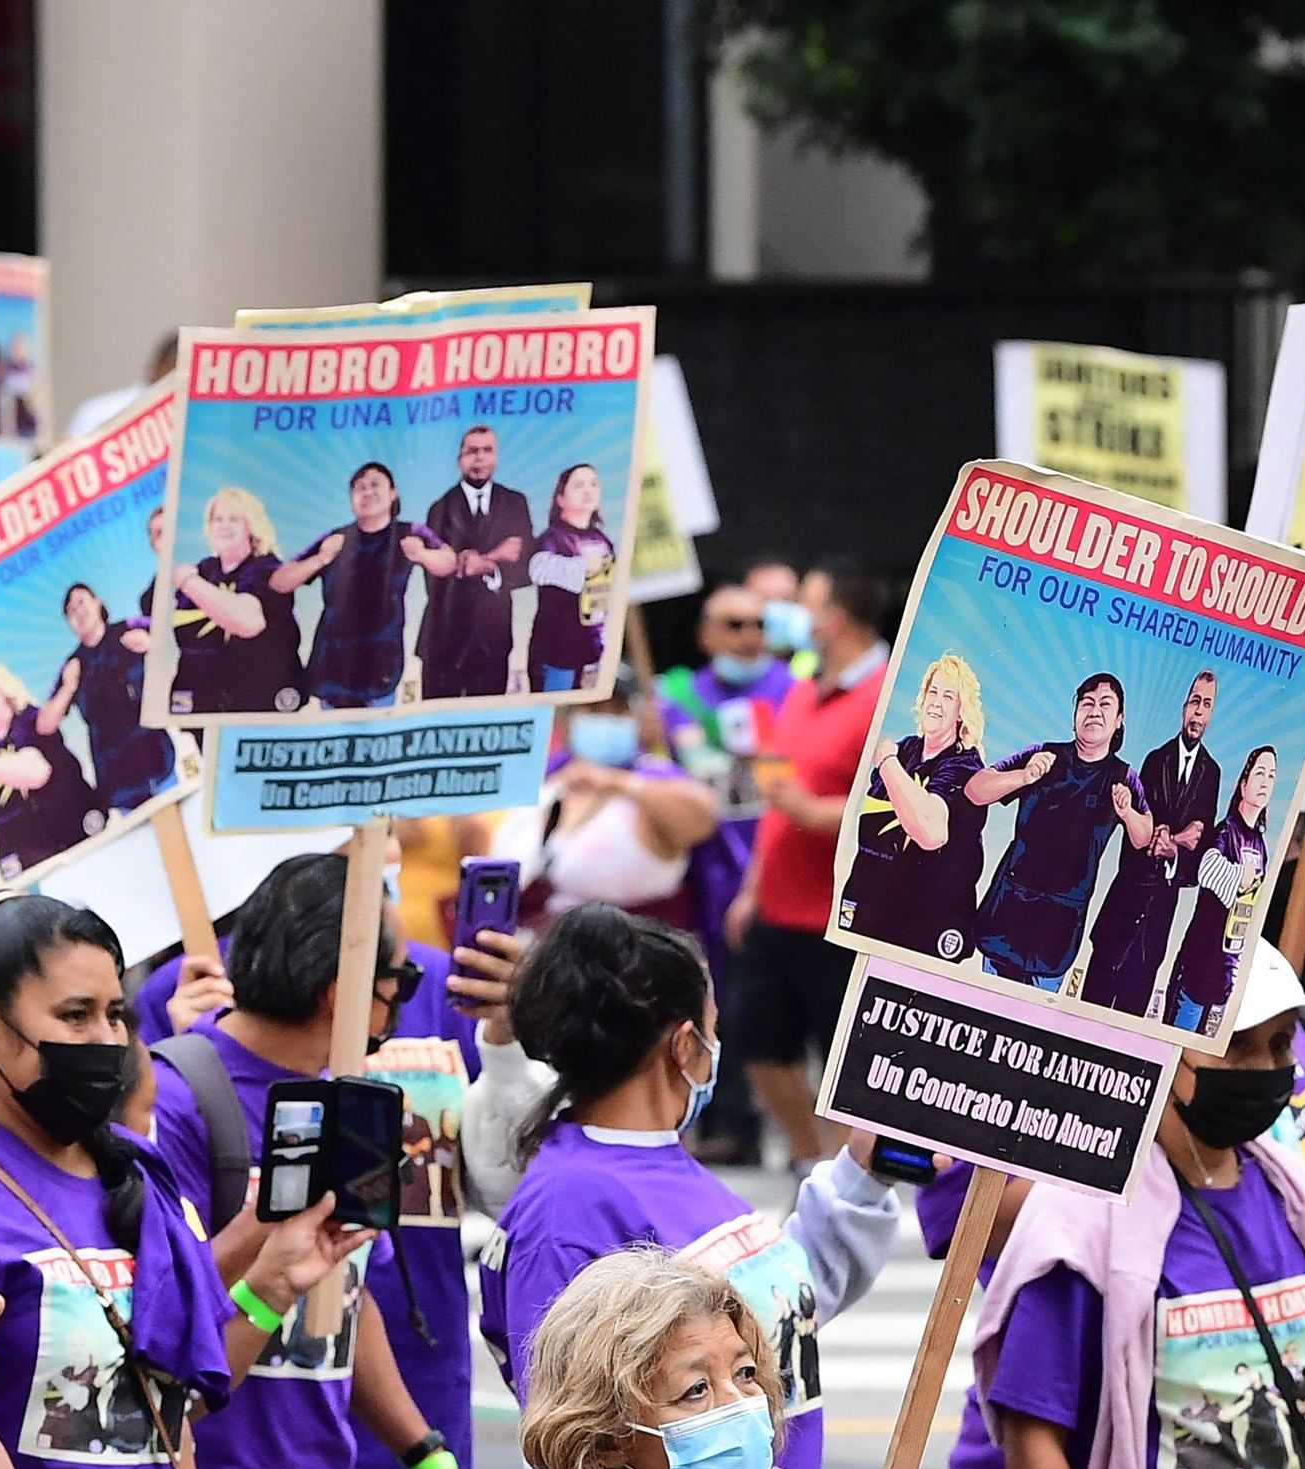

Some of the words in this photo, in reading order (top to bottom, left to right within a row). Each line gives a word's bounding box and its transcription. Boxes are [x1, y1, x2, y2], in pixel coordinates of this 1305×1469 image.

[196, 345, 401, 396] HOMBRO
[411, 344, 435, 390] A
[444, 329, 636, 382] HOMBRO
[254, 403, 315, 431] POR
[331, 400, 392, 428] UNA
[406, 396, 461, 425] VIDA
[474, 388, 575, 419] MEJOR
[55, 453, 101, 507] TO
[956, 475, 1162, 588] SHOULDER
[1164, 538, 1209, 602] TO
[978, 554, 1033, 597] FOR
[1039, 573, 1097, 618] OUR
[1107, 595, 1200, 648] SHARED
[1201, 627, 1303, 681] HUMANITY
[235, 737, 348, 769] JUSTICE
[352, 735, 404, 764] FOR
[862, 996, 988, 1058] JUSTICE
[991, 1032, 1045, 1076] FOR
[1042, 1050, 1153, 1107] JANITORS!
[866, 1053, 903, 1095] Un
[904, 1066, 1014, 1129] Contrato
[1010, 1102, 1058, 1143] Justo
[1055, 1111, 1124, 1160] Ahora!
